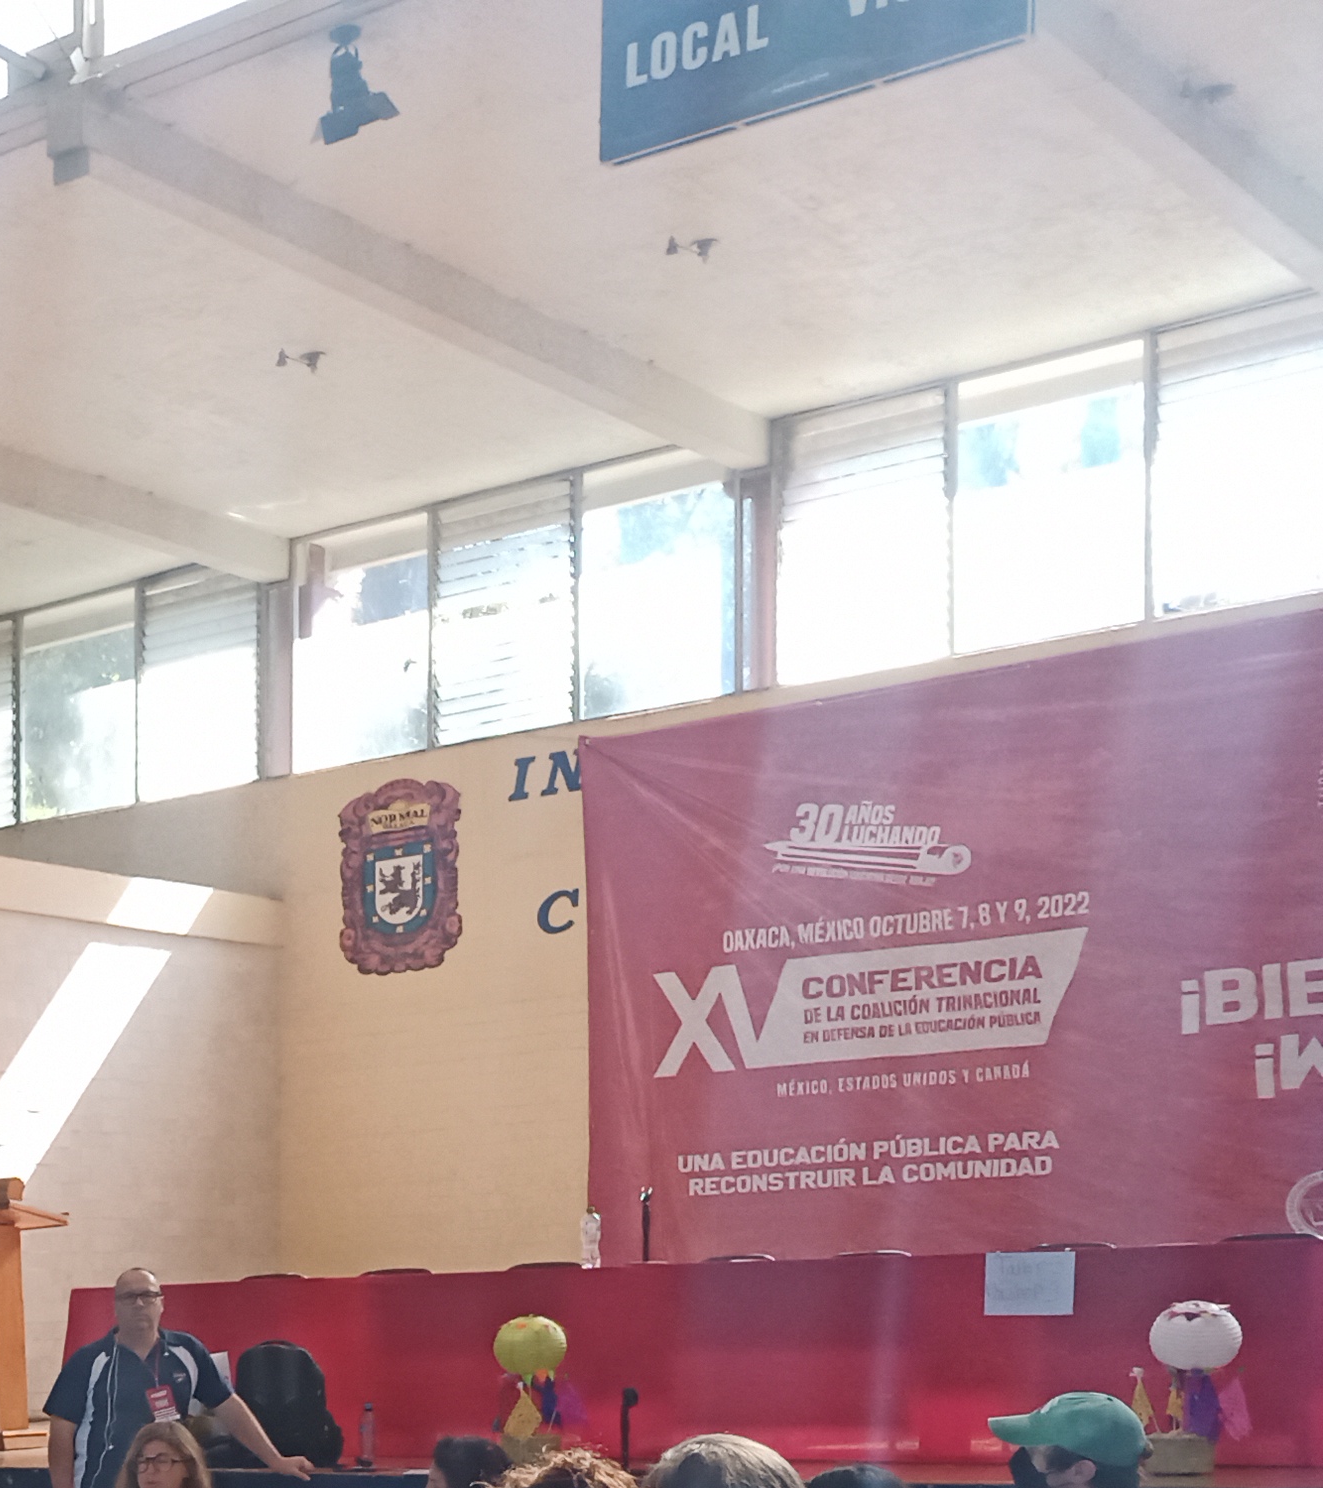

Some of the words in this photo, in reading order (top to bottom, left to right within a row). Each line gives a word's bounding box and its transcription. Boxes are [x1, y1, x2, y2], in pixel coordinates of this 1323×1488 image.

[625, 4, 769, 89] LOCAL
[789, 803, 845, 844] 30
[845, 800, 896, 825] AÑOS
[842, 825, 942, 845] LUCHANDO
[722, 925, 796, 953] OAXACA,
[798, 917, 865, 944] MÉXICO
[869, 908, 955, 938] OCTUBRE
[957, 906, 975, 930] 7,
[978, 903, 992, 926] 8
[995, 900, 1008, 924] Y
[1013, 899, 1031, 924] 9,
[1037, 891, 1090, 920] 2022
[801, 955, 1044, 1000] CONFERENCIA
[653, 959, 789, 1078] XV
[802, 1030, 820, 1044] EN
[822, 1024, 876, 1043] DEFENSA
[878, 1022, 896, 1039] DE
[898, 1021, 913, 1036] LA
[915, 1013, 987, 1035] EDUCACIÓN
[989, 1009, 1043, 1029] PÚBLICA
[803, 1007, 823, 1025] DE
[826, 1004, 846, 1022] LA
[850, 994, 930, 1021] COALICIÓN
[935, 987, 1042, 1014] TRINACIONAL
[776, 1077, 834, 1098] MÉXICO,
[838, 1072, 898, 1093] ESTADOS
[902, 1069, 957, 1088] UNIDOS
[962, 1068, 971, 1084] Y
[975, 1059, 1030, 1083] CANADÁ
[677, 1152, 726, 1174] UNA
[730, 1137, 867, 1171] EDUCACIÓN
[873, 1134, 982, 1161] PÚBLICA
[988, 1130, 1060, 1154] PARA
[688, 1168, 857, 1197] RECONSTRUIR
[862, 1165, 896, 1187] LA
[902, 1155, 1053, 1183] COMUNIDAD
